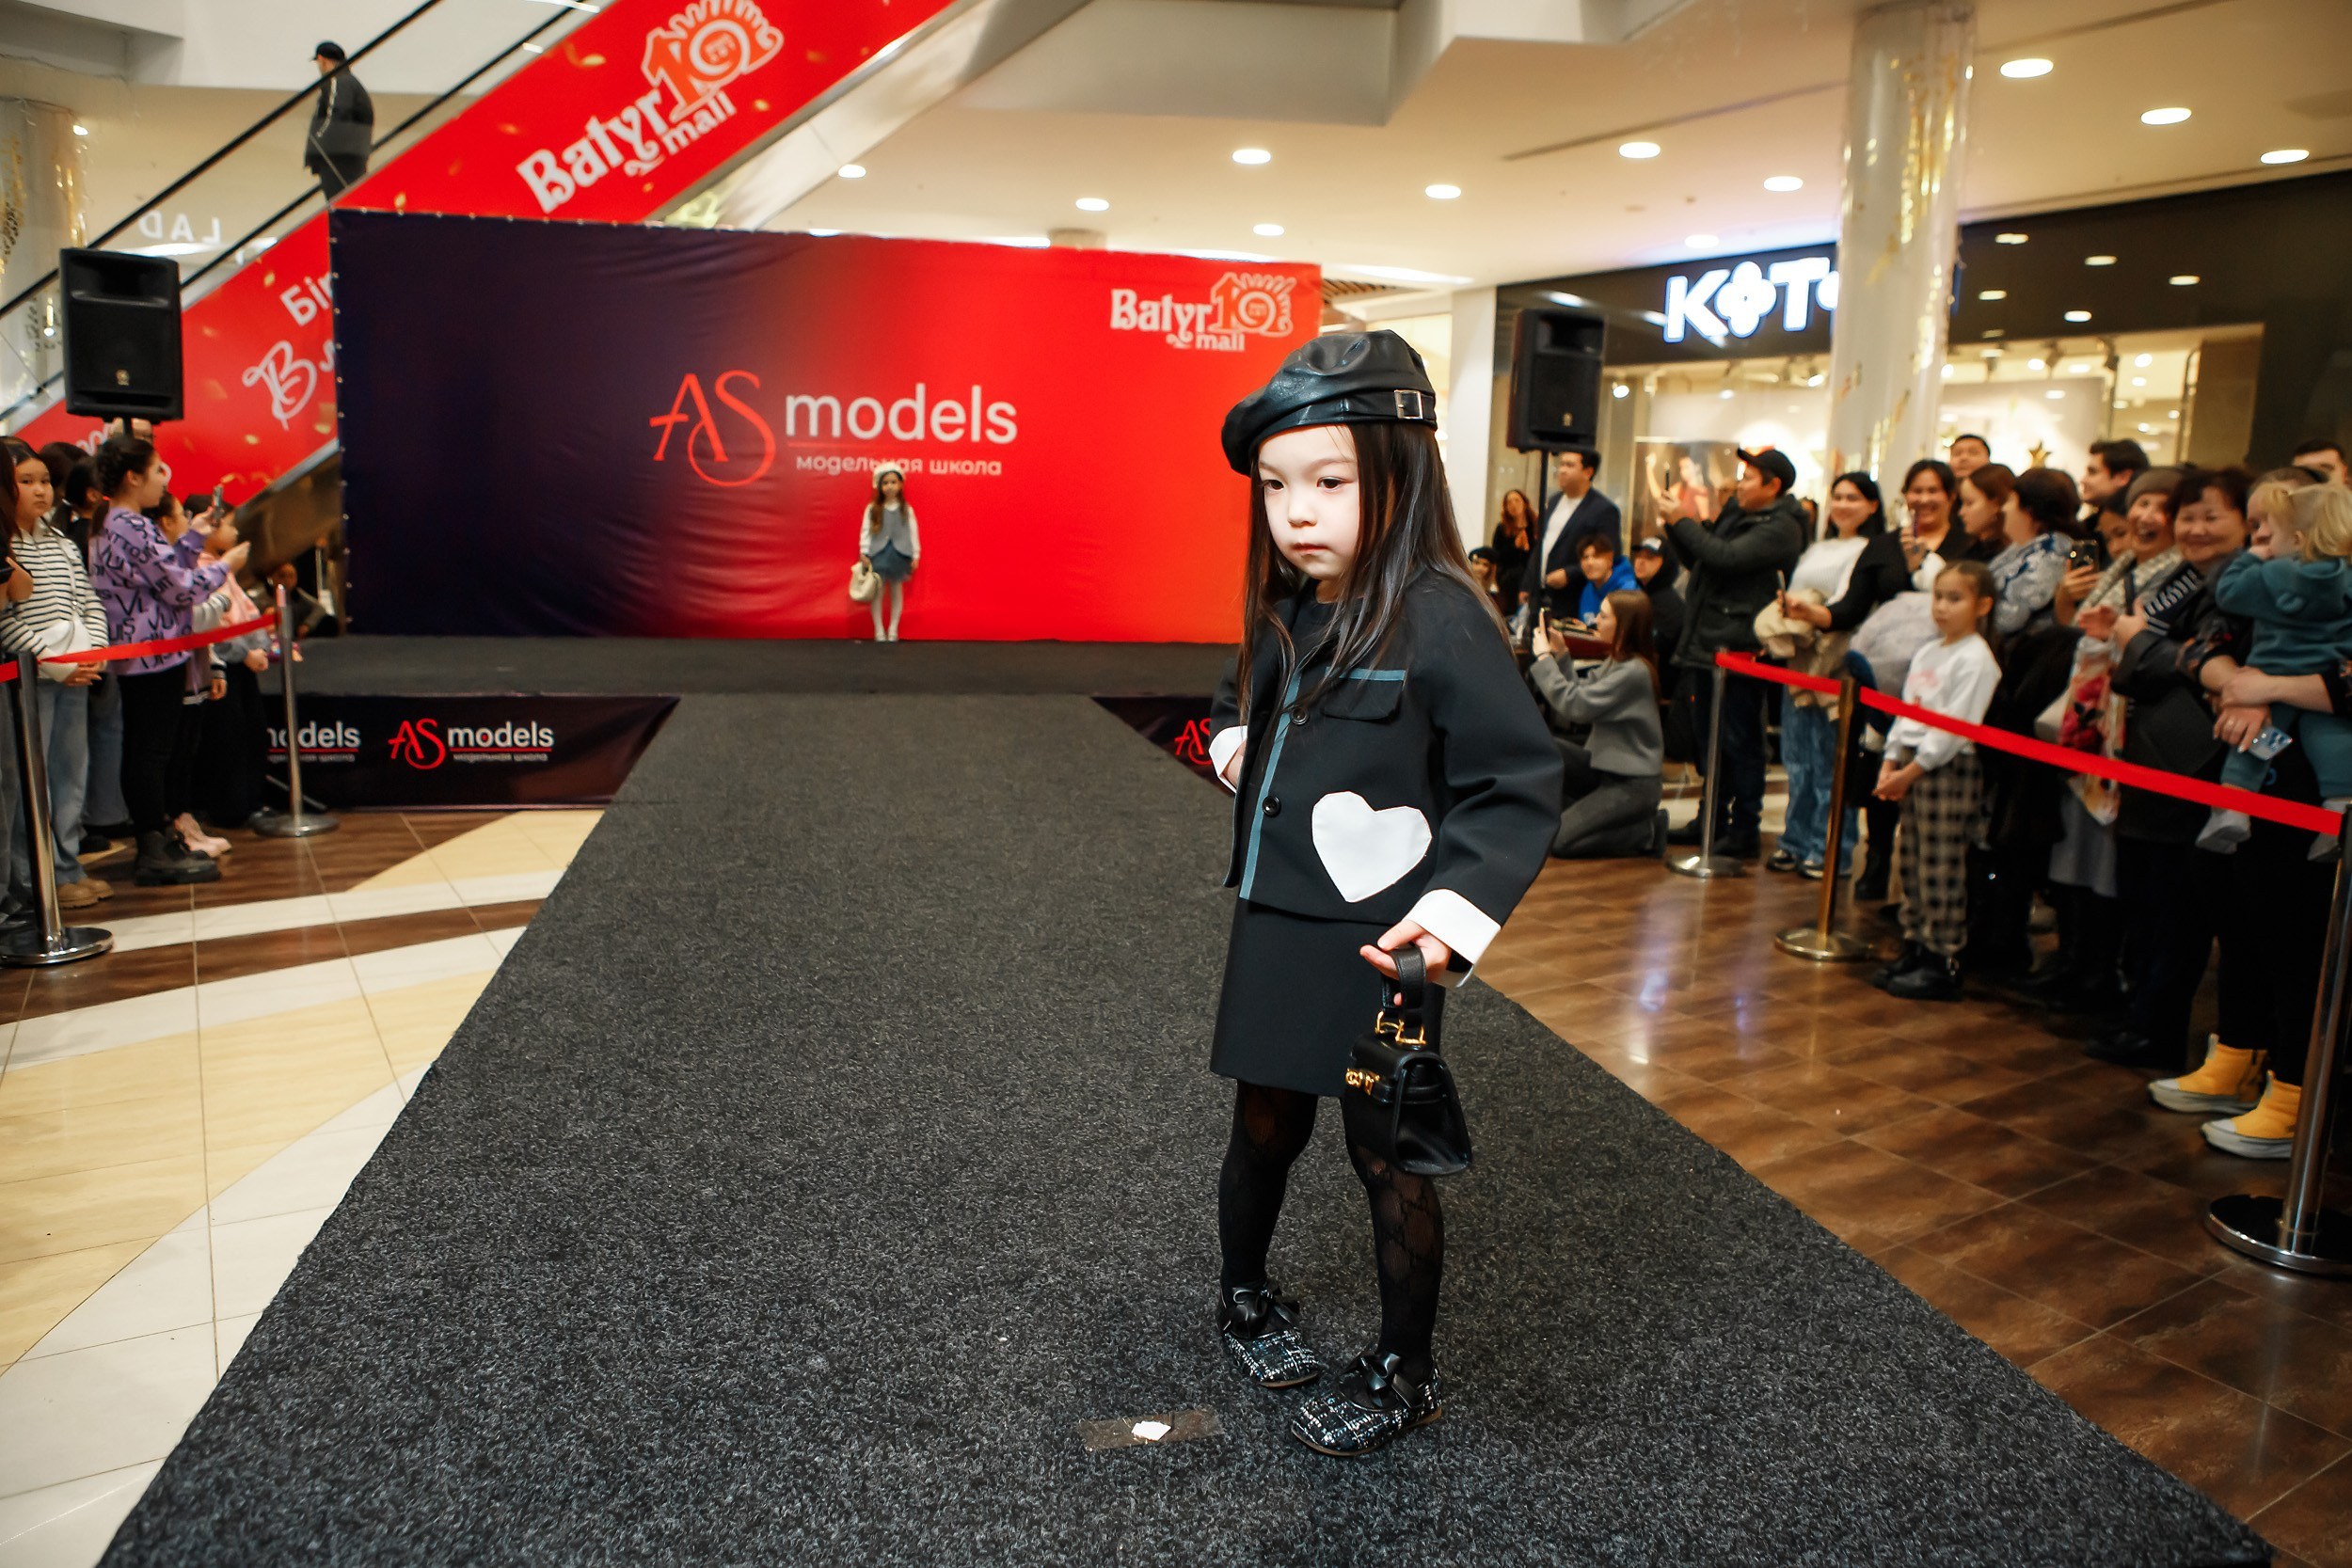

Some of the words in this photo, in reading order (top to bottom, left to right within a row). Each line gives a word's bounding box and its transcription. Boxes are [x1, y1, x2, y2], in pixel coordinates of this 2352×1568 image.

[516, 87, 670, 214] Batyr
[660, 90, 737, 155] mall
[1109, 288, 1214, 346] Batyr
[1195, 332, 1245, 352] mall
[649, 370, 776, 487] AS
[786, 383, 1018, 444] models
[796, 455, 923, 475] модельая
[930, 459, 1002, 476] школа
[388, 718, 446, 769] AS
[448, 721, 554, 748] models
